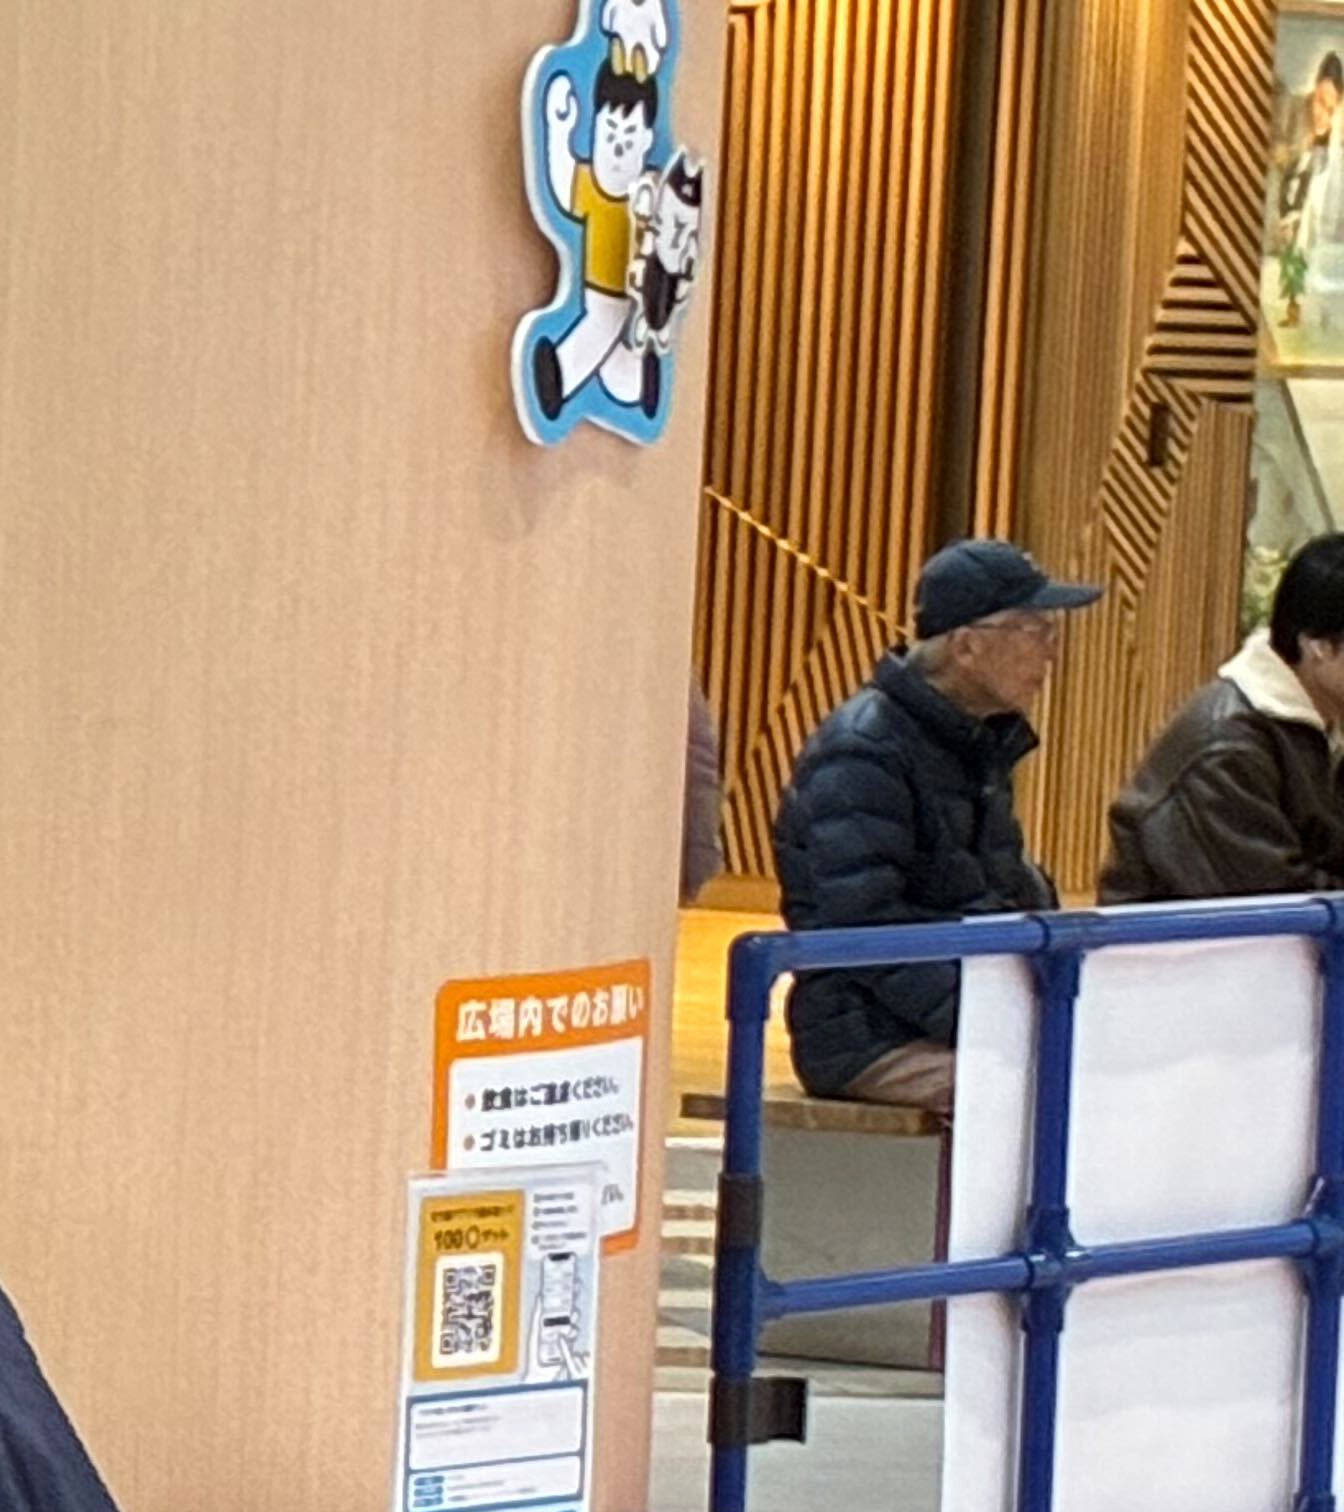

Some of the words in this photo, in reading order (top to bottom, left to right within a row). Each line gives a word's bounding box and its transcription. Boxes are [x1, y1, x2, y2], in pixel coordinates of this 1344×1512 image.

[455, 983, 643, 1043] 広場内でのお願い
